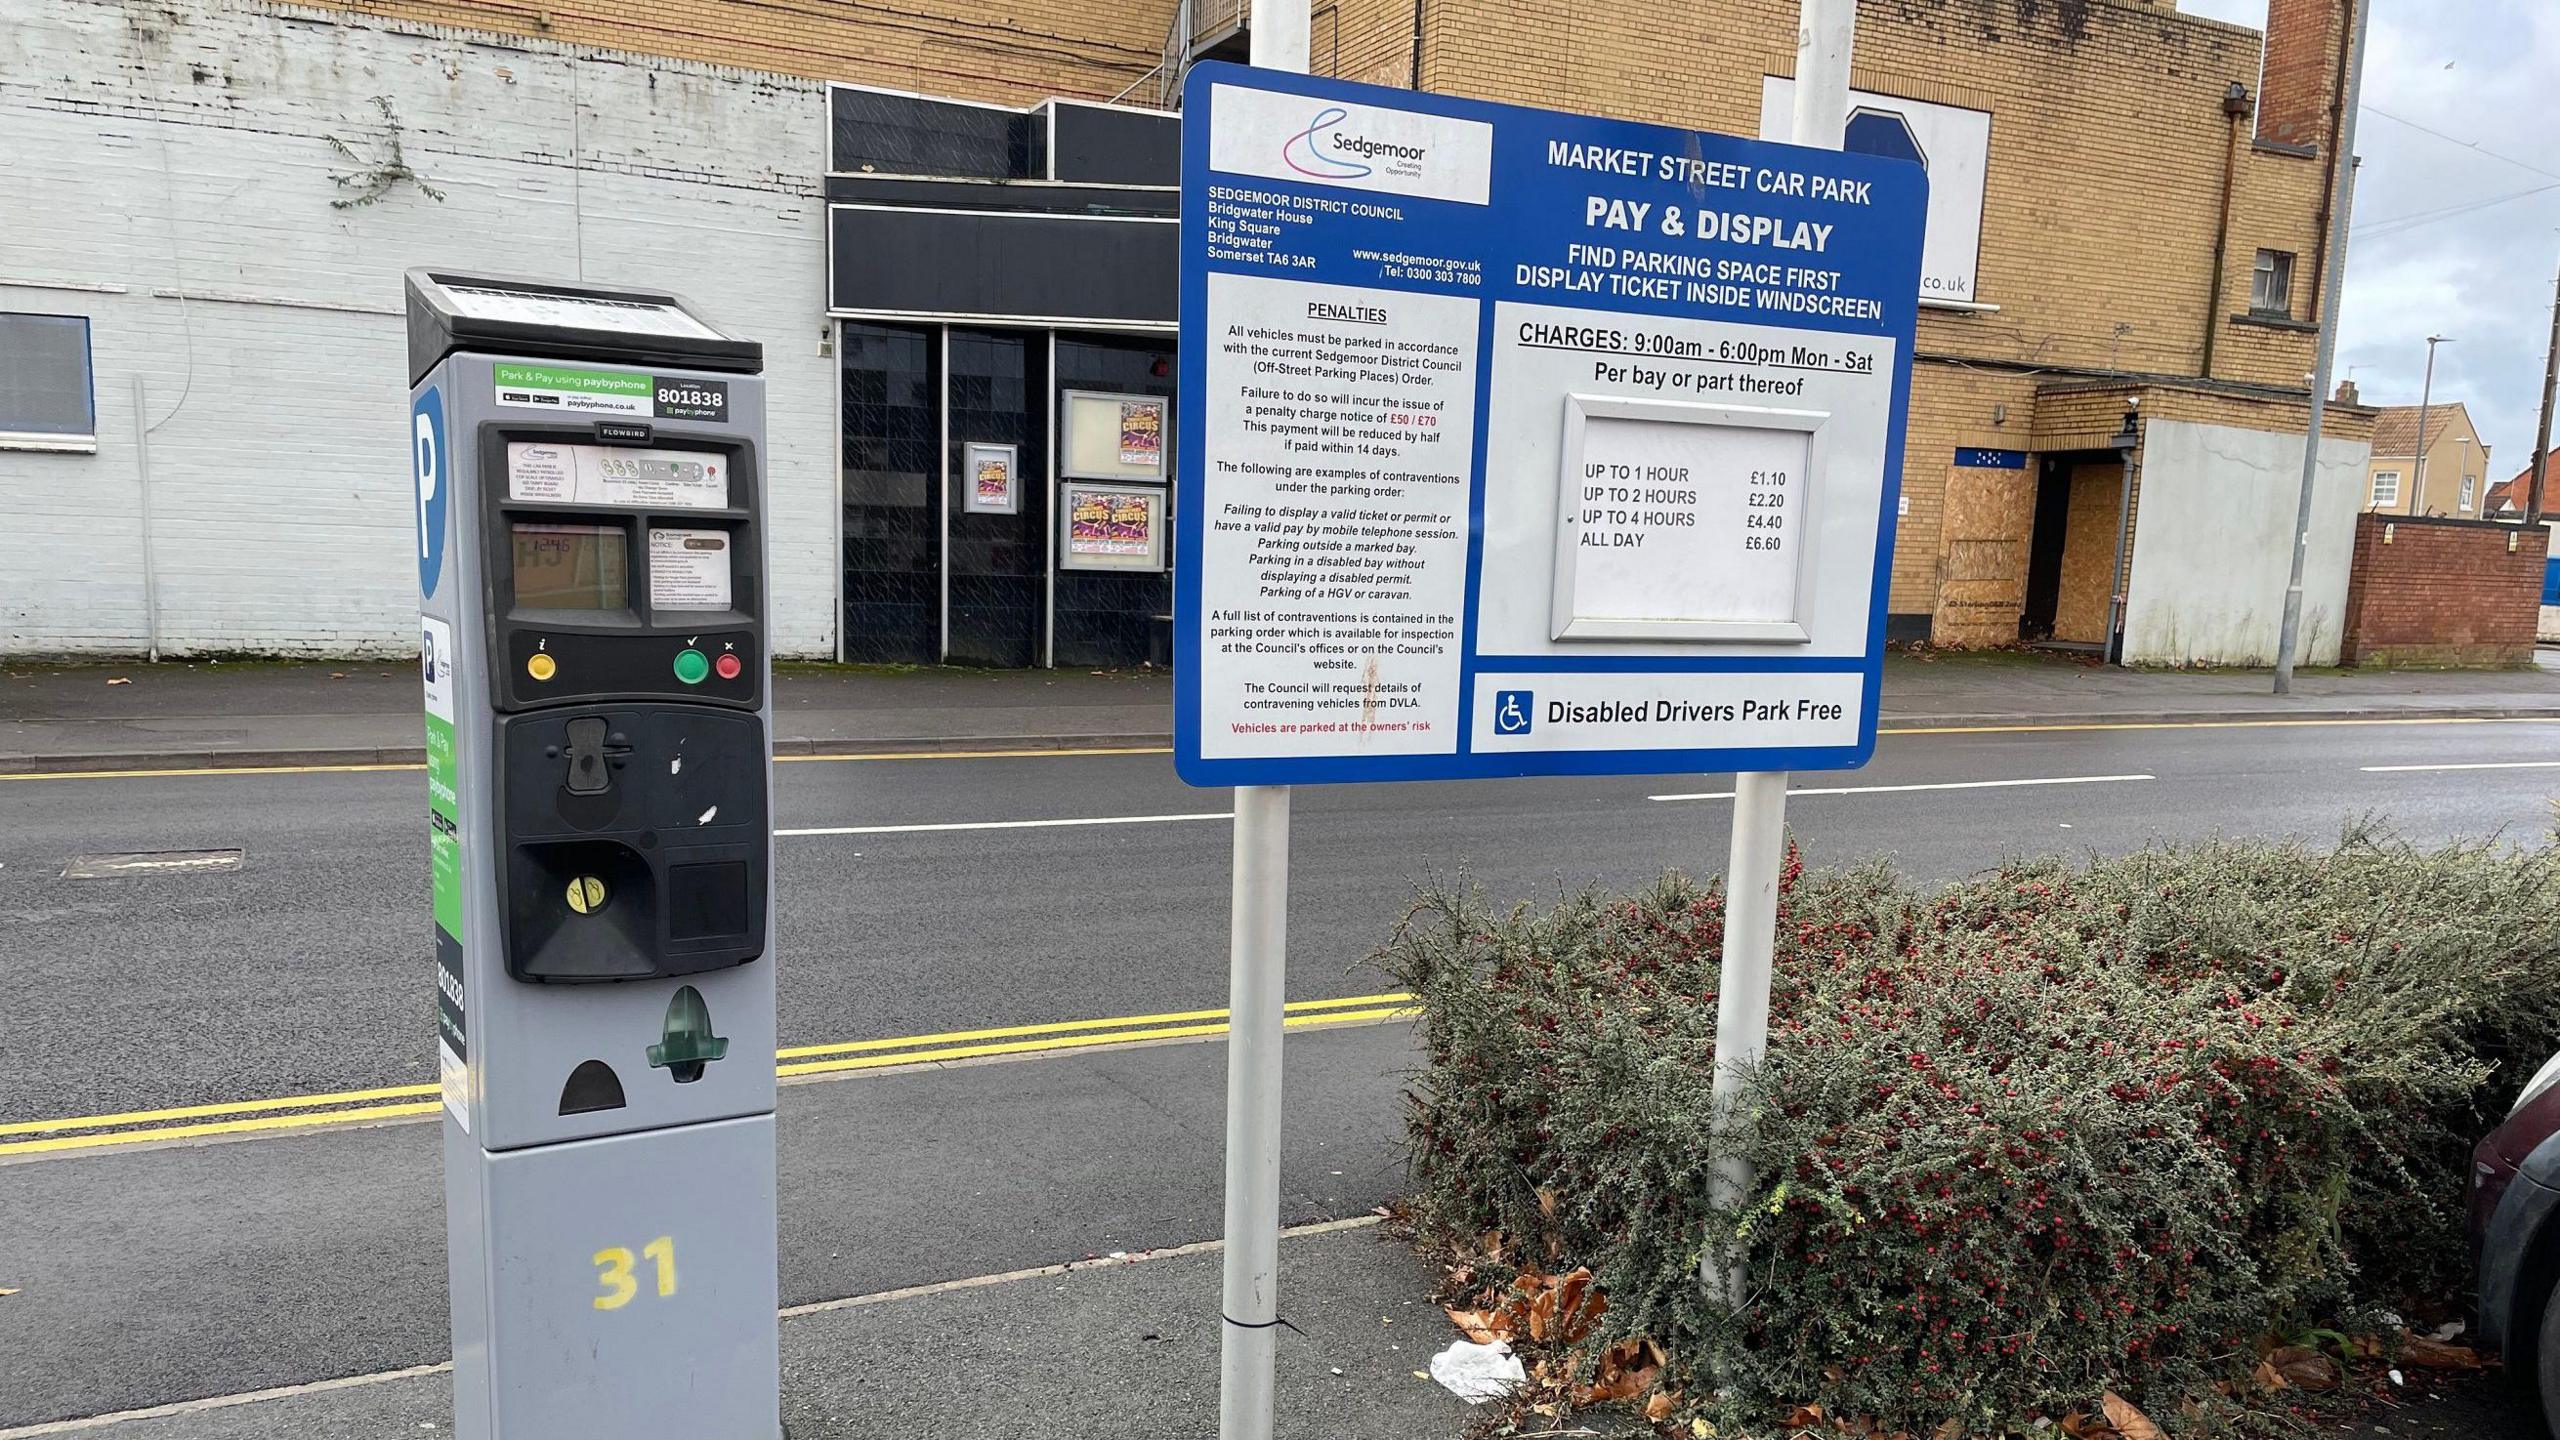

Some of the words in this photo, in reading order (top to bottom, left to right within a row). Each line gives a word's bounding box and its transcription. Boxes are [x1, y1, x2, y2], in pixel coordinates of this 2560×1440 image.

[1333, 132, 1425, 161] Sedgemoor
[1385, 166, 1422, 179] Opportunity
[1397, 160, 1422, 172] Creating
[1547, 139, 1654, 177] MARKET
[1658, 155, 1751, 190] STREET
[1756, 168, 1805, 197] CAR
[1810, 175, 1872, 205] PARK
[1208, 185, 1290, 208] SEDGEMOOR
[1292, 195, 1349, 214] DISTRICT
[1350, 202, 1404, 221] COUNCIL
[1208, 200, 1274, 220] Bridgwater
[1275, 208, 1313, 225] House
[1207, 215, 1236, 233] King
[1238, 219, 1281, 236] Square
[1586, 195, 1652, 232] PAY
[1660, 205, 1686, 237] &
[1696, 209, 1834, 253] DISPLAY
[1207, 230, 1273, 249] Bridgwater
[1207, 245, 1265, 264] Somerset
[1266, 251, 1289, 266] TA6
[1291, 254, 1316, 269] 3AR
[1352, 249, 1481, 272] www.sedgemoor.gov.uk
[1568, 243, 1616, 268] FIND
[1621, 249, 1712, 279] PARKING
[1716, 259, 1782, 286] SPACE
[1786, 267, 1841, 291] FIRST
[1385, 264, 1404, 278] Tel:
[1406, 266, 1433, 281] 0300
[1434, 269, 1454, 283] 303
[1456, 271, 1481, 286] 7800
[1516, 263, 1605, 293] DISPLAY
[1608, 273, 1683, 301] TICKET
[1686, 281, 1751, 308] INSIDE
[1755, 288, 1882, 320] WINDSCREEN
[1307, 301, 1387, 323] PENALTIES
[1227, 324, 1244, 337] All
[1246, 327, 1294, 342] vehicles
[1296, 333, 1326, 345] must
[1327, 333, 1342, 346] be
[1344, 336, 1382, 349] parked
[1384, 338, 1395, 350] in
[1397, 341, 1459, 356] accordance
[1519, 321, 1628, 351] CHARGES:
[1634, 333, 1702, 358] 9:00am
[1719, 339, 1786, 367] 6:00pm
[1791, 346, 1829, 368] Mon
[1845, 350, 1873, 371] Sat
[1222, 341, 1248, 354] with
[1250, 343, 1269, 356] the
[1271, 347, 1313, 360] current
[1314, 348, 1379, 365] Sedgemoor
[1380, 354, 1420, 369] District
[1421, 357, 1462, 372] Council
[501, 369, 523, 381] Park
[525, 372, 533, 382] &
[535, 373, 553, 385] Pay
[555, 376, 582, 387] using
[583, 378, 646, 391] paybyphone
[1594, 361, 1628, 383] Per
[1632, 364, 1667, 391] bay
[1671, 372, 1693, 388] or
[1696, 372, 1734, 394] part
[1738, 373, 1805, 396] thereof
[567, 400, 636, 411] paybyphone.co.uk
[658, 388, 723, 407] 801838
[674, 407, 716, 417] paybyphone
[1245, 405, 1253, 415] a
[1254, 405, 1297, 420] penalty
[1299, 407, 1338, 423] charge
[1339, 411, 1374, 423] notice
[1375, 412, 1388, 424] of
[1389, 412, 1409, 425] £50
[1411, 414, 1416, 425] /
[1417, 415, 1437, 427] £70
[603, 428, 646, 438] FLOWBIRD
[1122, 420, 1159, 432] CIRCUS
[1284, 438, 1293, 451] if
[1294, 440, 1319, 453] paid
[1320, 441, 1354, 454] within
[1356, 443, 1370, 455] 14
[1371, 444, 1400, 459] days.
[1216, 460, 1238, 473] The
[1240, 461, 1292, 479] following
[1294, 467, 1313, 477] are
[1315, 467, 1367, 481] examples
[1369, 469, 1381, 481] of
[1382, 471, 1460, 485] contraventions
[1585, 463, 1606, 479] UP
[1609, 464, 1630, 480] TO
[1634, 465, 1641, 481] 1
[1646, 465, 1689, 483] HOUR
[1750, 470, 1786, 486] £1.10
[1583, 485, 1604, 502] UP
[1607, 487, 1629, 503] TO
[1631, 487, 1641, 503] 2
[1644, 488, 1697, 505] HOURS
[1748, 492, 1784, 508] £2.20
[1073, 509, 1110, 522] CIRCUS
[1111, 511, 1147, 523] CIRCUS
[1582, 508, 1603, 524] UP
[1606, 509, 1628, 525] TO
[1630, 510, 1640, 525] 4
[1643, 510, 1695, 527] HOURS
[1746, 514, 1783, 530] £4.40
[1579, 531, 1609, 547] ALL
[1613, 532, 1645, 548] DAY
[1745, 535, 1781, 551] £6.60
[1210, 626, 1253, 640] parking
[1255, 626, 1286, 638] order
[1287, 626, 1320, 638] which
[1322, 627, 1332, 639] is
[1334, 627, 1381, 639] available
[1383, 627, 1399, 639] for
[1400, 628, 1454, 642] inspection
[1312, 658, 1357, 670] website.
[1243, 697, 1314, 712] contravening
[1316, 697, 1360, 709] vehicles
[1362, 697, 1387, 709] from
[1389, 697, 1421, 708] DVLA.
[1547, 700, 1649, 723] Disabled
[1655, 700, 1735, 722] Drivers
[1741, 699, 1790, 721] Park
[1796, 699, 1842, 721] Free
[1231, 722, 1277, 734] Vehicles
[1279, 724, 1297, 733] are
[1299, 721, 1336, 735] parked
[1338, 722, 1349, 732] at
[1350, 721, 1368, 732] the
[1369, 721, 1410, 732] owners'
[1411, 720, 1431, 731] risk
[438, 961, 464, 1012] 801838
[592, 1236, 679, 1312] 31
